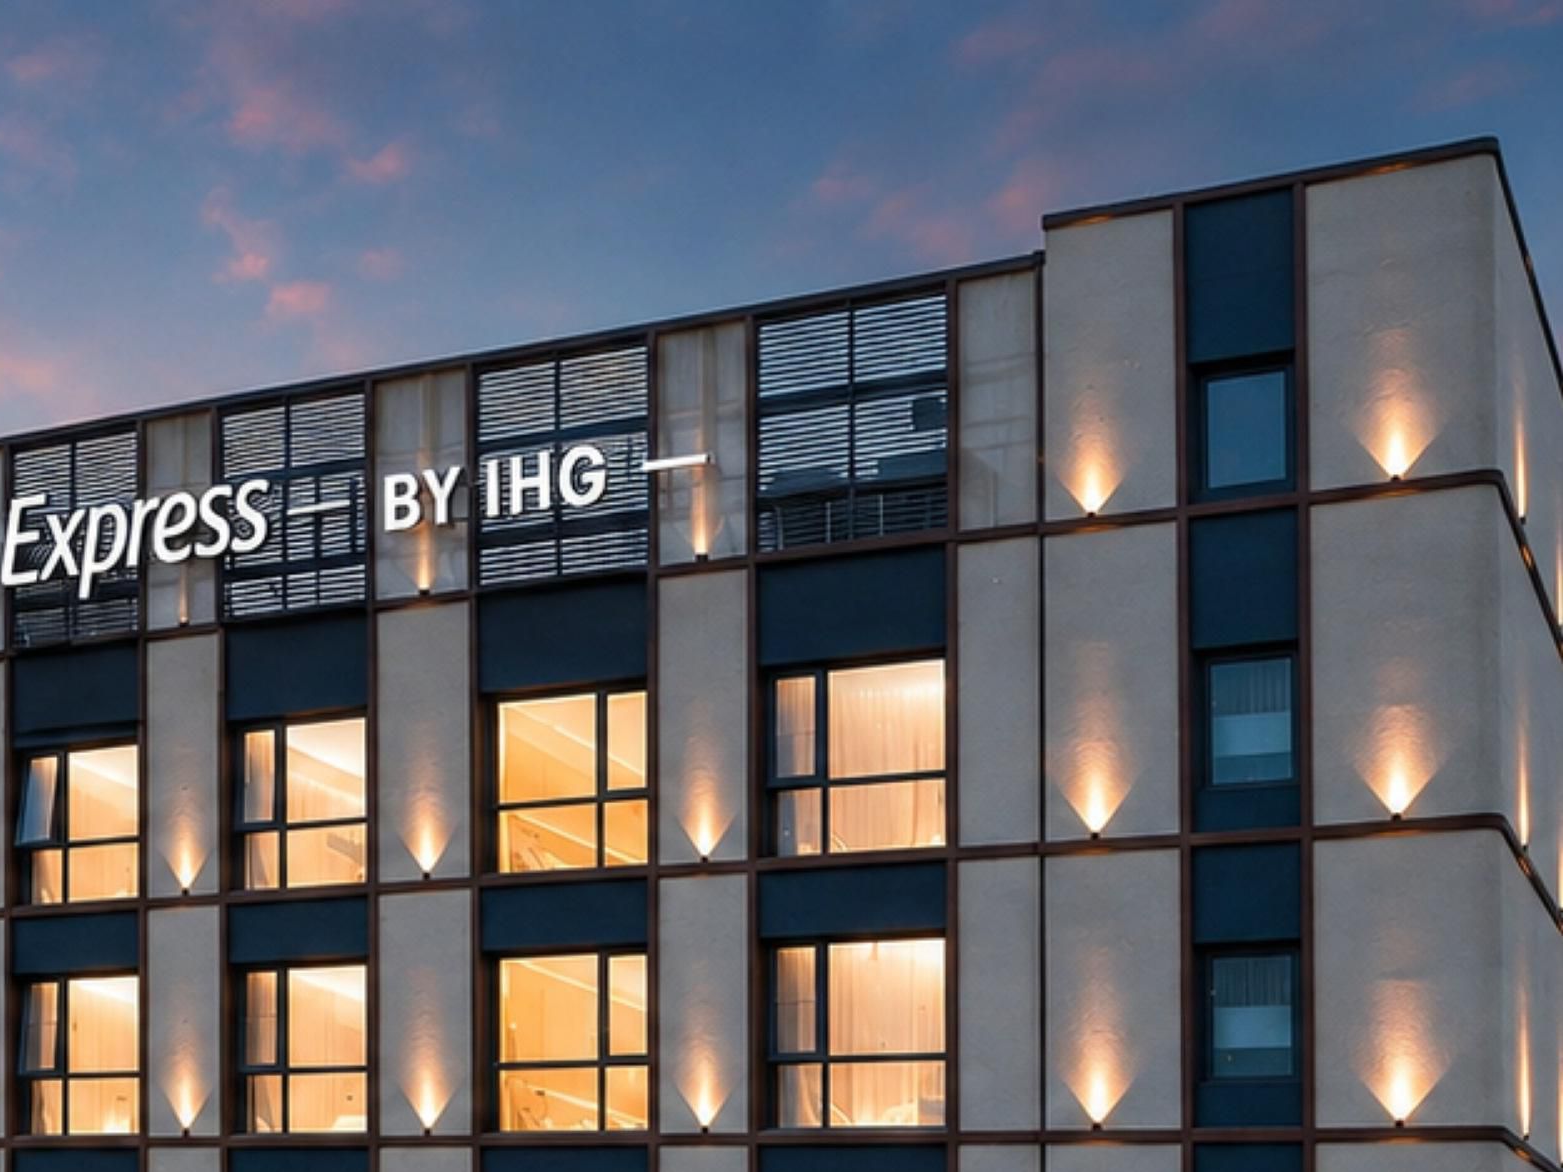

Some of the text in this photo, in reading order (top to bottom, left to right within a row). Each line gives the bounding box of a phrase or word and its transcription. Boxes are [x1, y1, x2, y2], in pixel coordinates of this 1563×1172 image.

[0, 479, 268, 598] Express
[383, 465, 461, 531] BY
[486, 445, 606, 518] IHG
